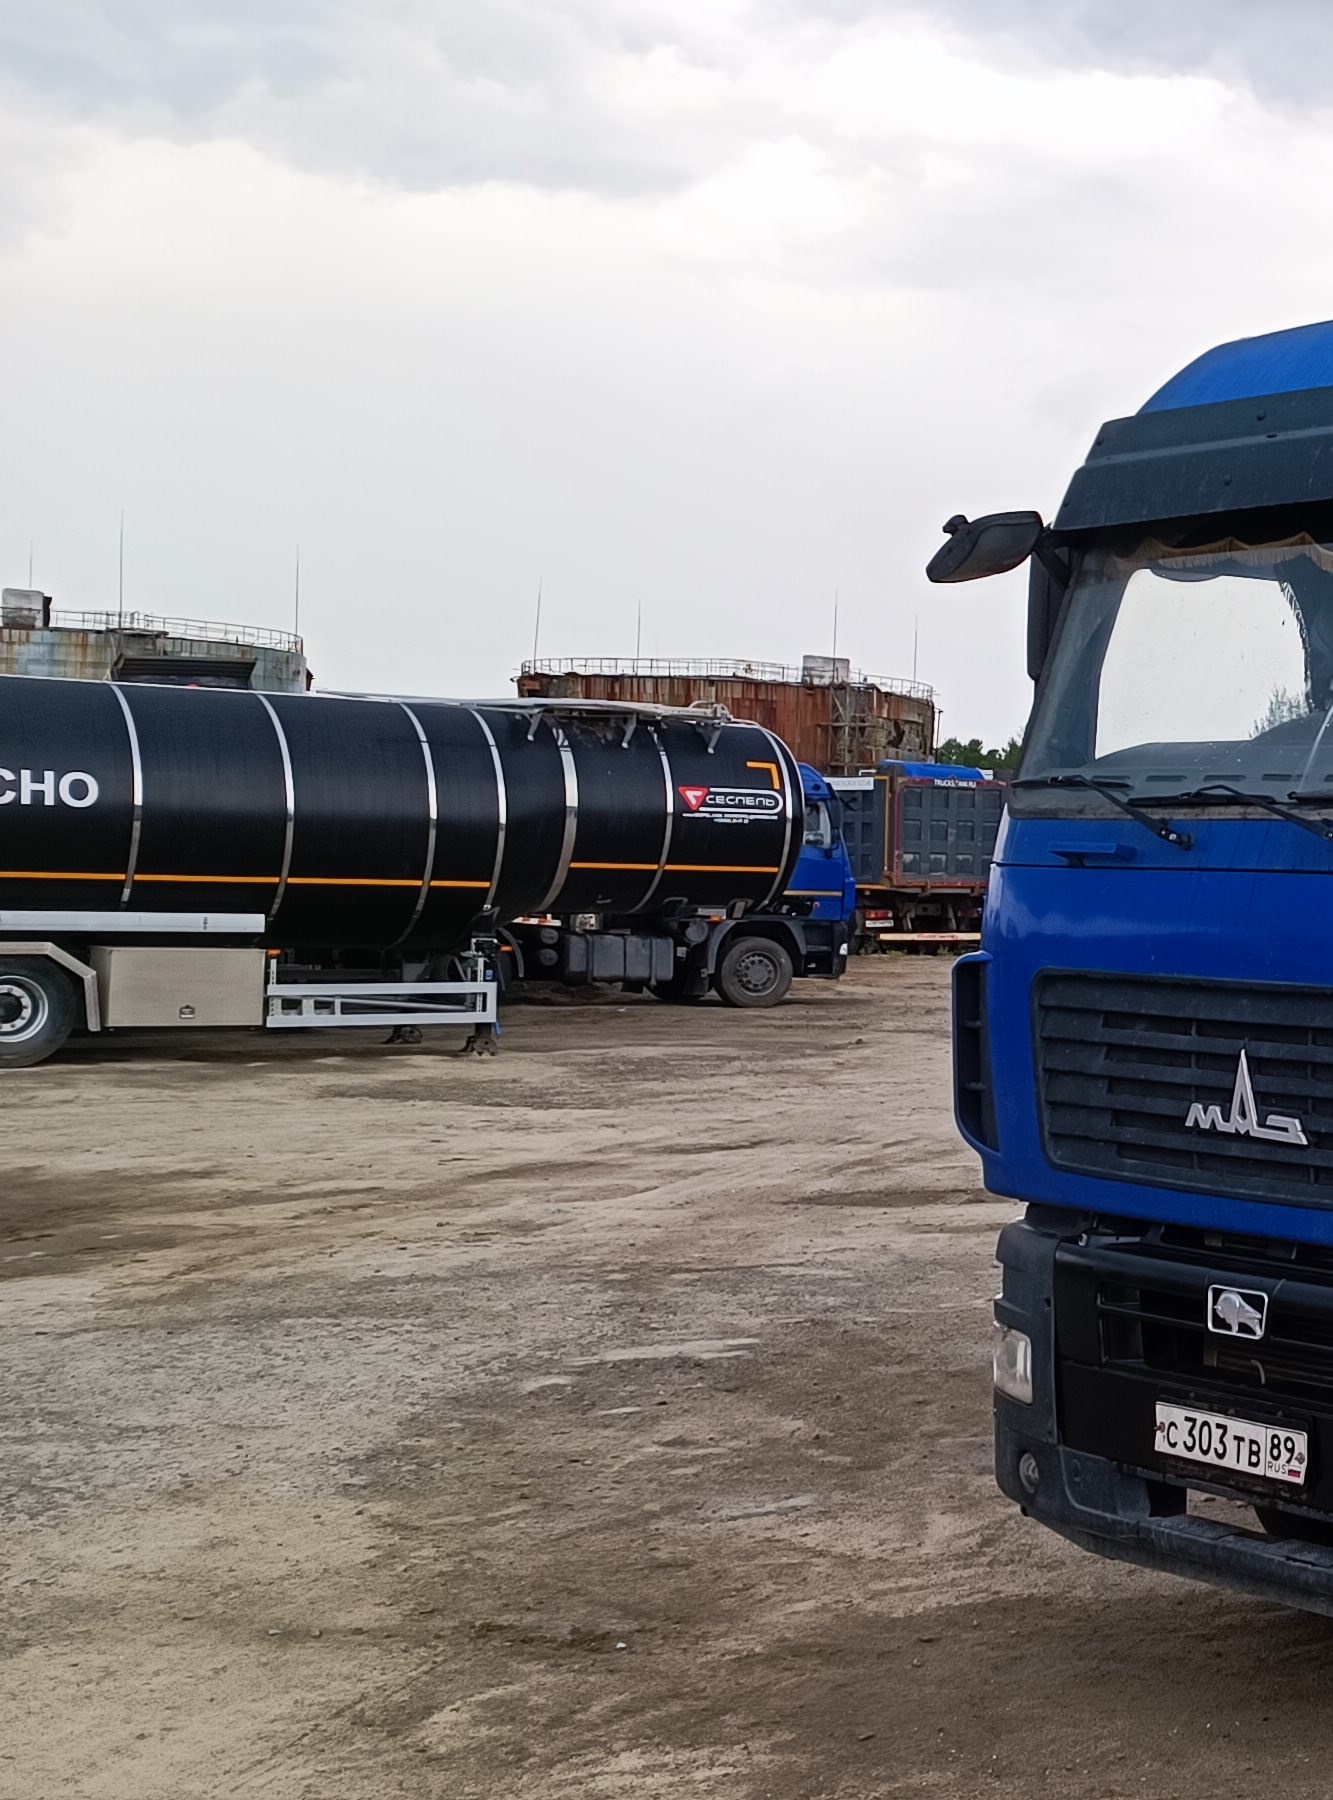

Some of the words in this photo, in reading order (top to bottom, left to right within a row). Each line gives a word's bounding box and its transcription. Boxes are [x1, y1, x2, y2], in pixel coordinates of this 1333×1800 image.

[1185, 1048, 1308, 1145] МАЗ
[1269, 1434, 1296, 1464] 89
[1267, 1460, 1287, 1475] RUS
